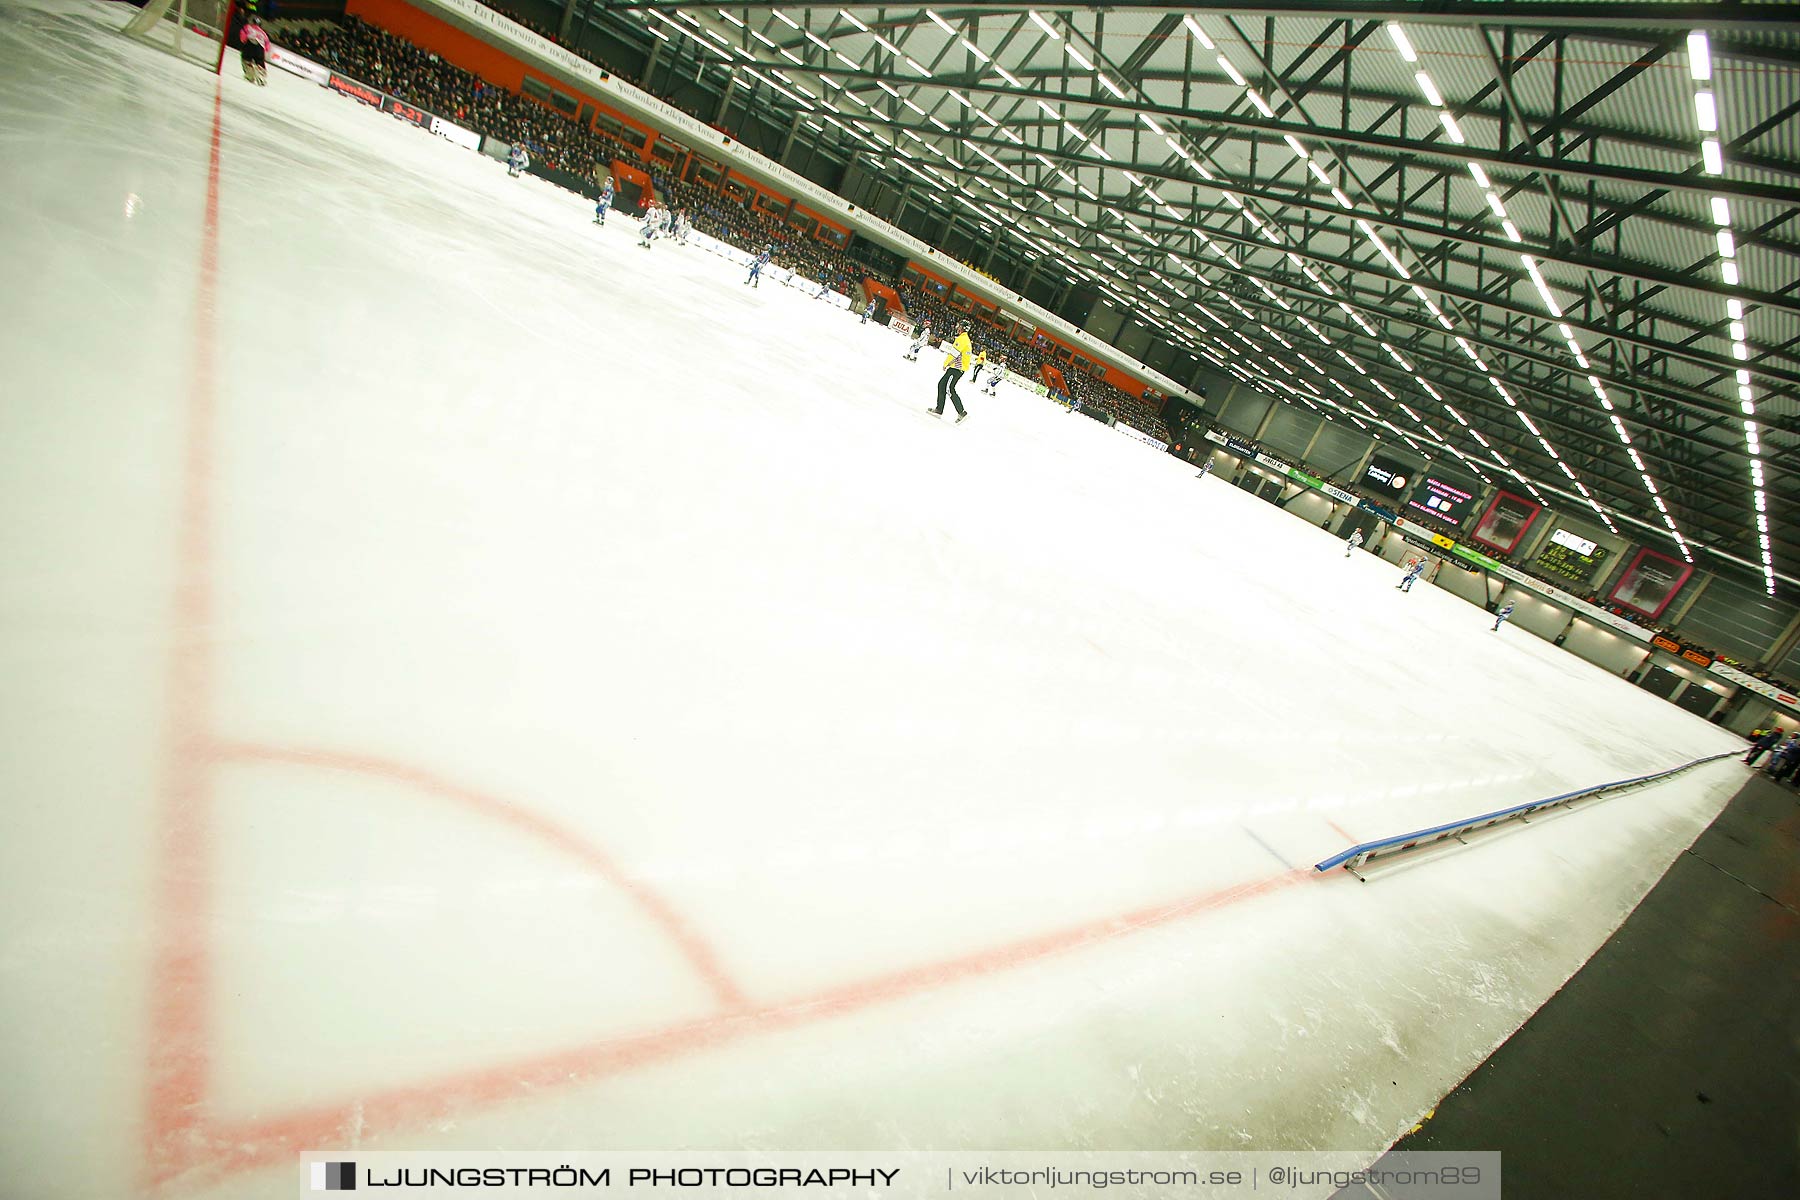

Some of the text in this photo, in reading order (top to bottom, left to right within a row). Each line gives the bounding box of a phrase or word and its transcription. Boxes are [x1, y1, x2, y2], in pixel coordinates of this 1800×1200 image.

[393, 101, 422, 121] 9-21
[615, 80, 716, 138] Sparbanken Lidköping Arena
[746, 150, 764, 164] Arena
[894, 321, 910, 332] JULA
[1332, 488, 1353, 501] STENA
